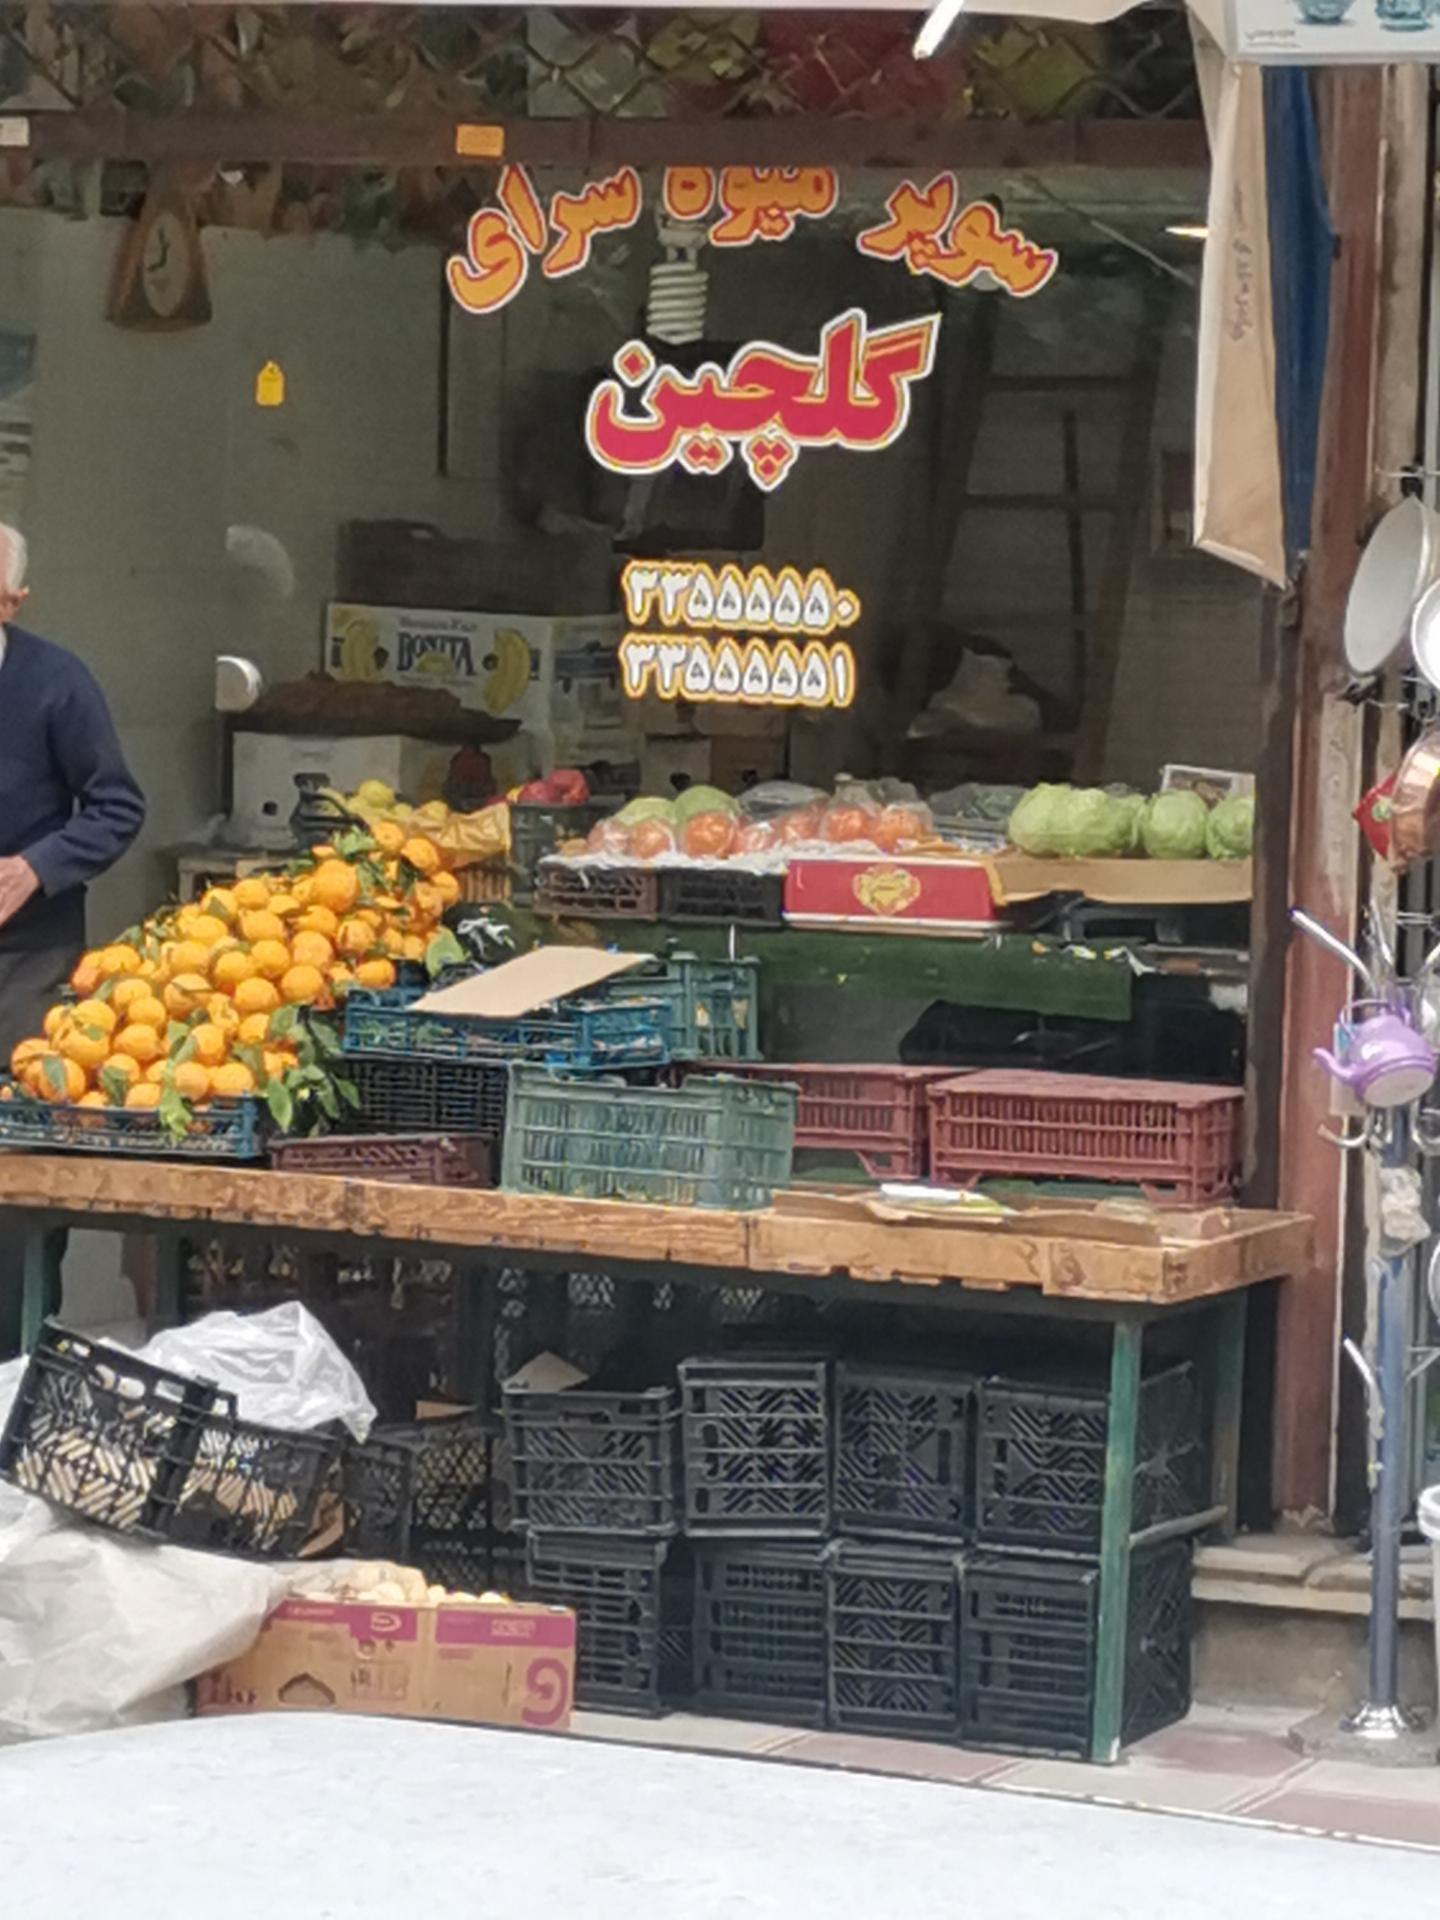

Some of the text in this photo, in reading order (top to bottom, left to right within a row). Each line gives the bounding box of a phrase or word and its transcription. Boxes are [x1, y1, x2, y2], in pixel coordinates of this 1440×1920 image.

[447, 164, 1058, 315] سوپر میوه سرای
[586, 309, 942, 491] گلچین
